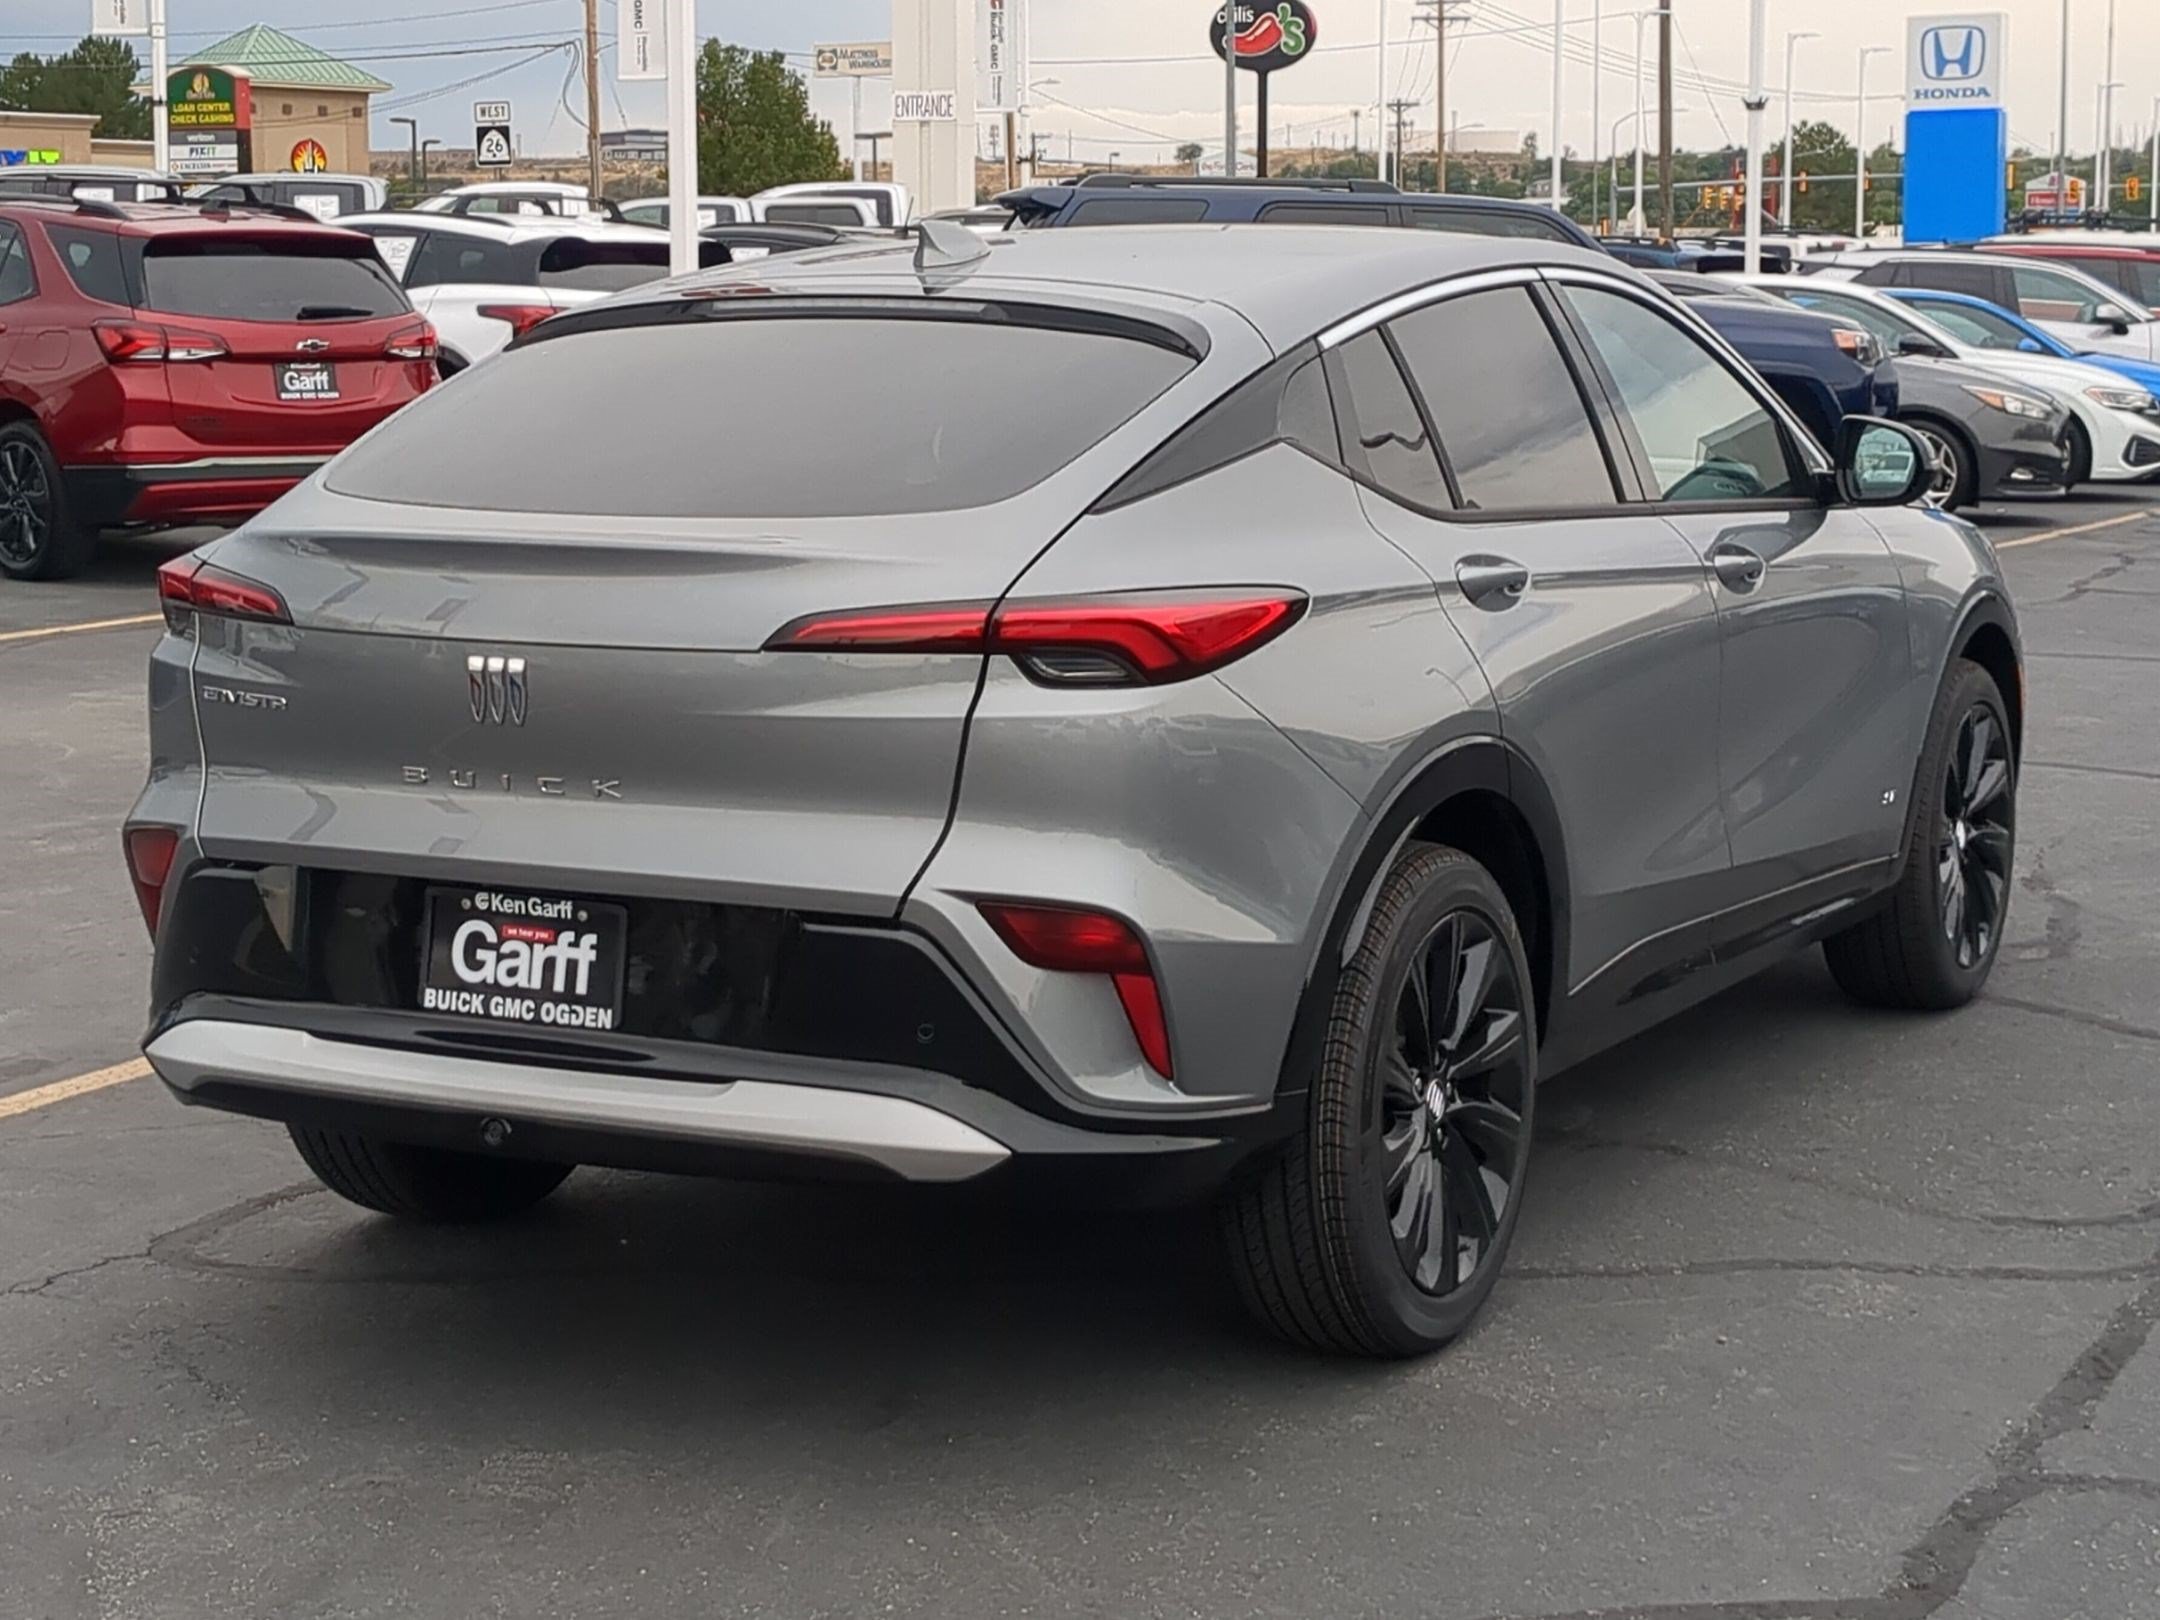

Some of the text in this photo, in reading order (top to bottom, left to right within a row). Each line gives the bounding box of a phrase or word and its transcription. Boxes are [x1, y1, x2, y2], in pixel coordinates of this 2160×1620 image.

[1217, 5, 1254, 24] cilis
[1913, 87, 1991, 100] HONDA
[197, 102, 231, 112] CENTER
[480, 105, 505, 118] WEST
[895, 94, 953, 118] ENTRANCE
[486, 138, 503, 153] 26
[283, 371, 329, 391] Garff
[402, 765, 622, 798] BUICK
[491, 893, 573, 919] Ken Garff
[451, 919, 598, 996] Garff
[423, 988, 613, 1030] BUICK GMC OGDEN
